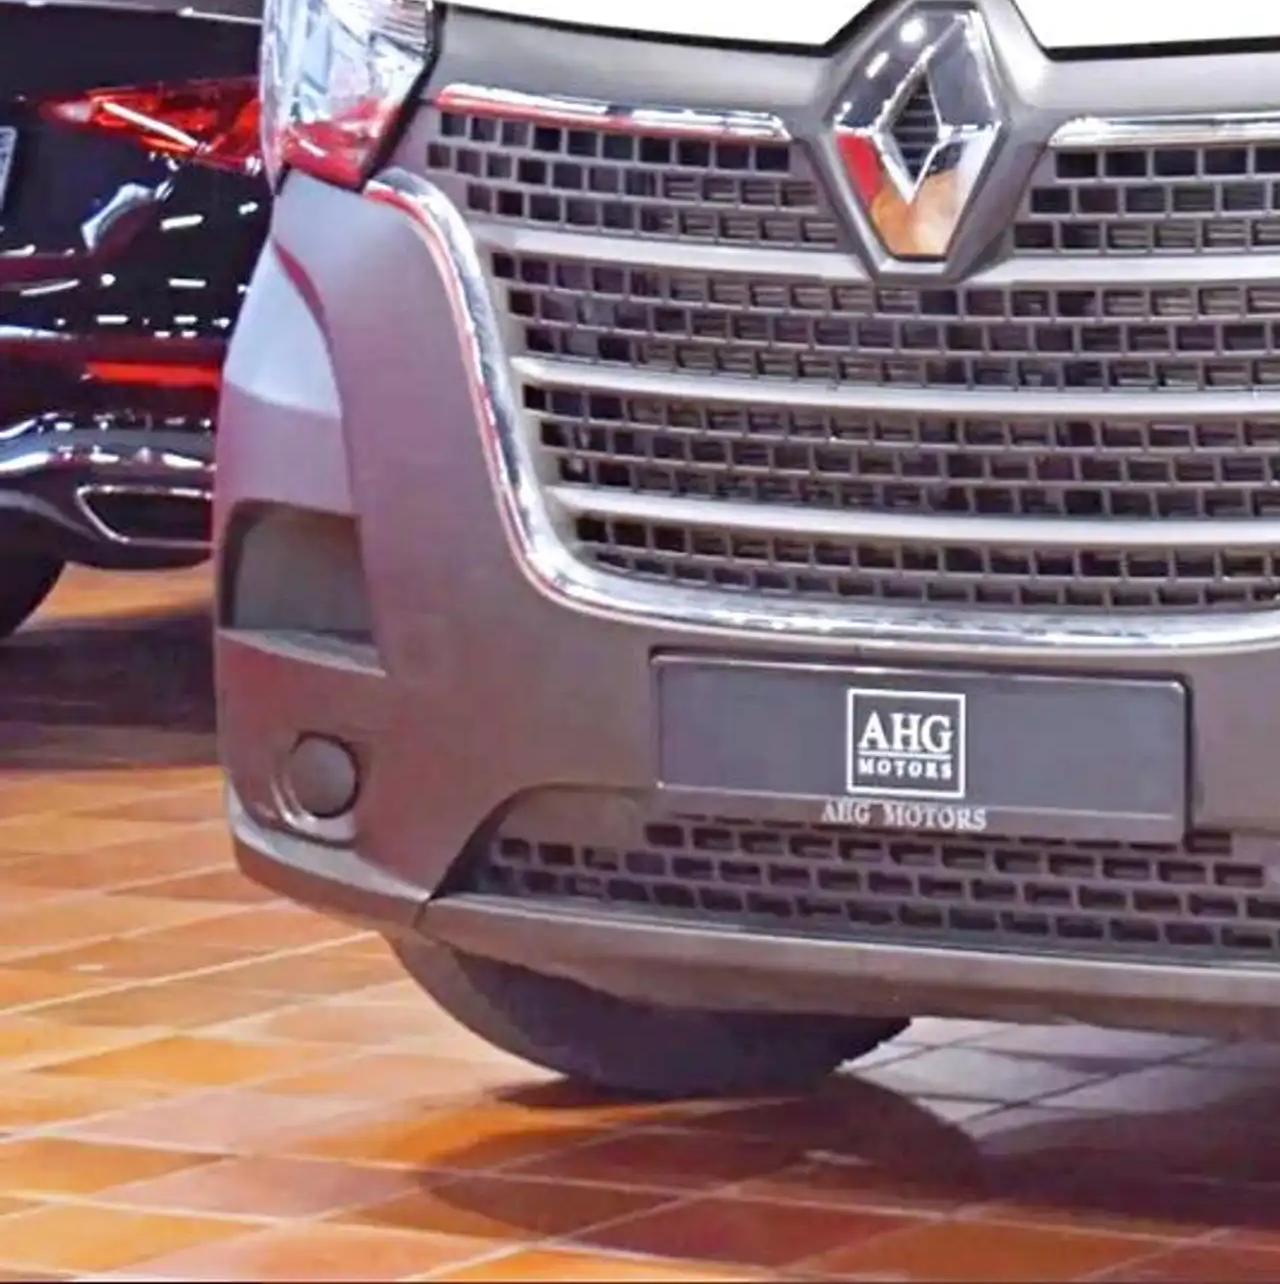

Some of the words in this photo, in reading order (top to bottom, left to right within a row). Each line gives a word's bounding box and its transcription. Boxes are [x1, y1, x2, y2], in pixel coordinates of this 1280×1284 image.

[857, 709, 953, 753] AHG
[857, 758, 953, 780] MOTORS
[821, 799, 871, 824] AHG
[882, 802, 987, 831] MOTORS
